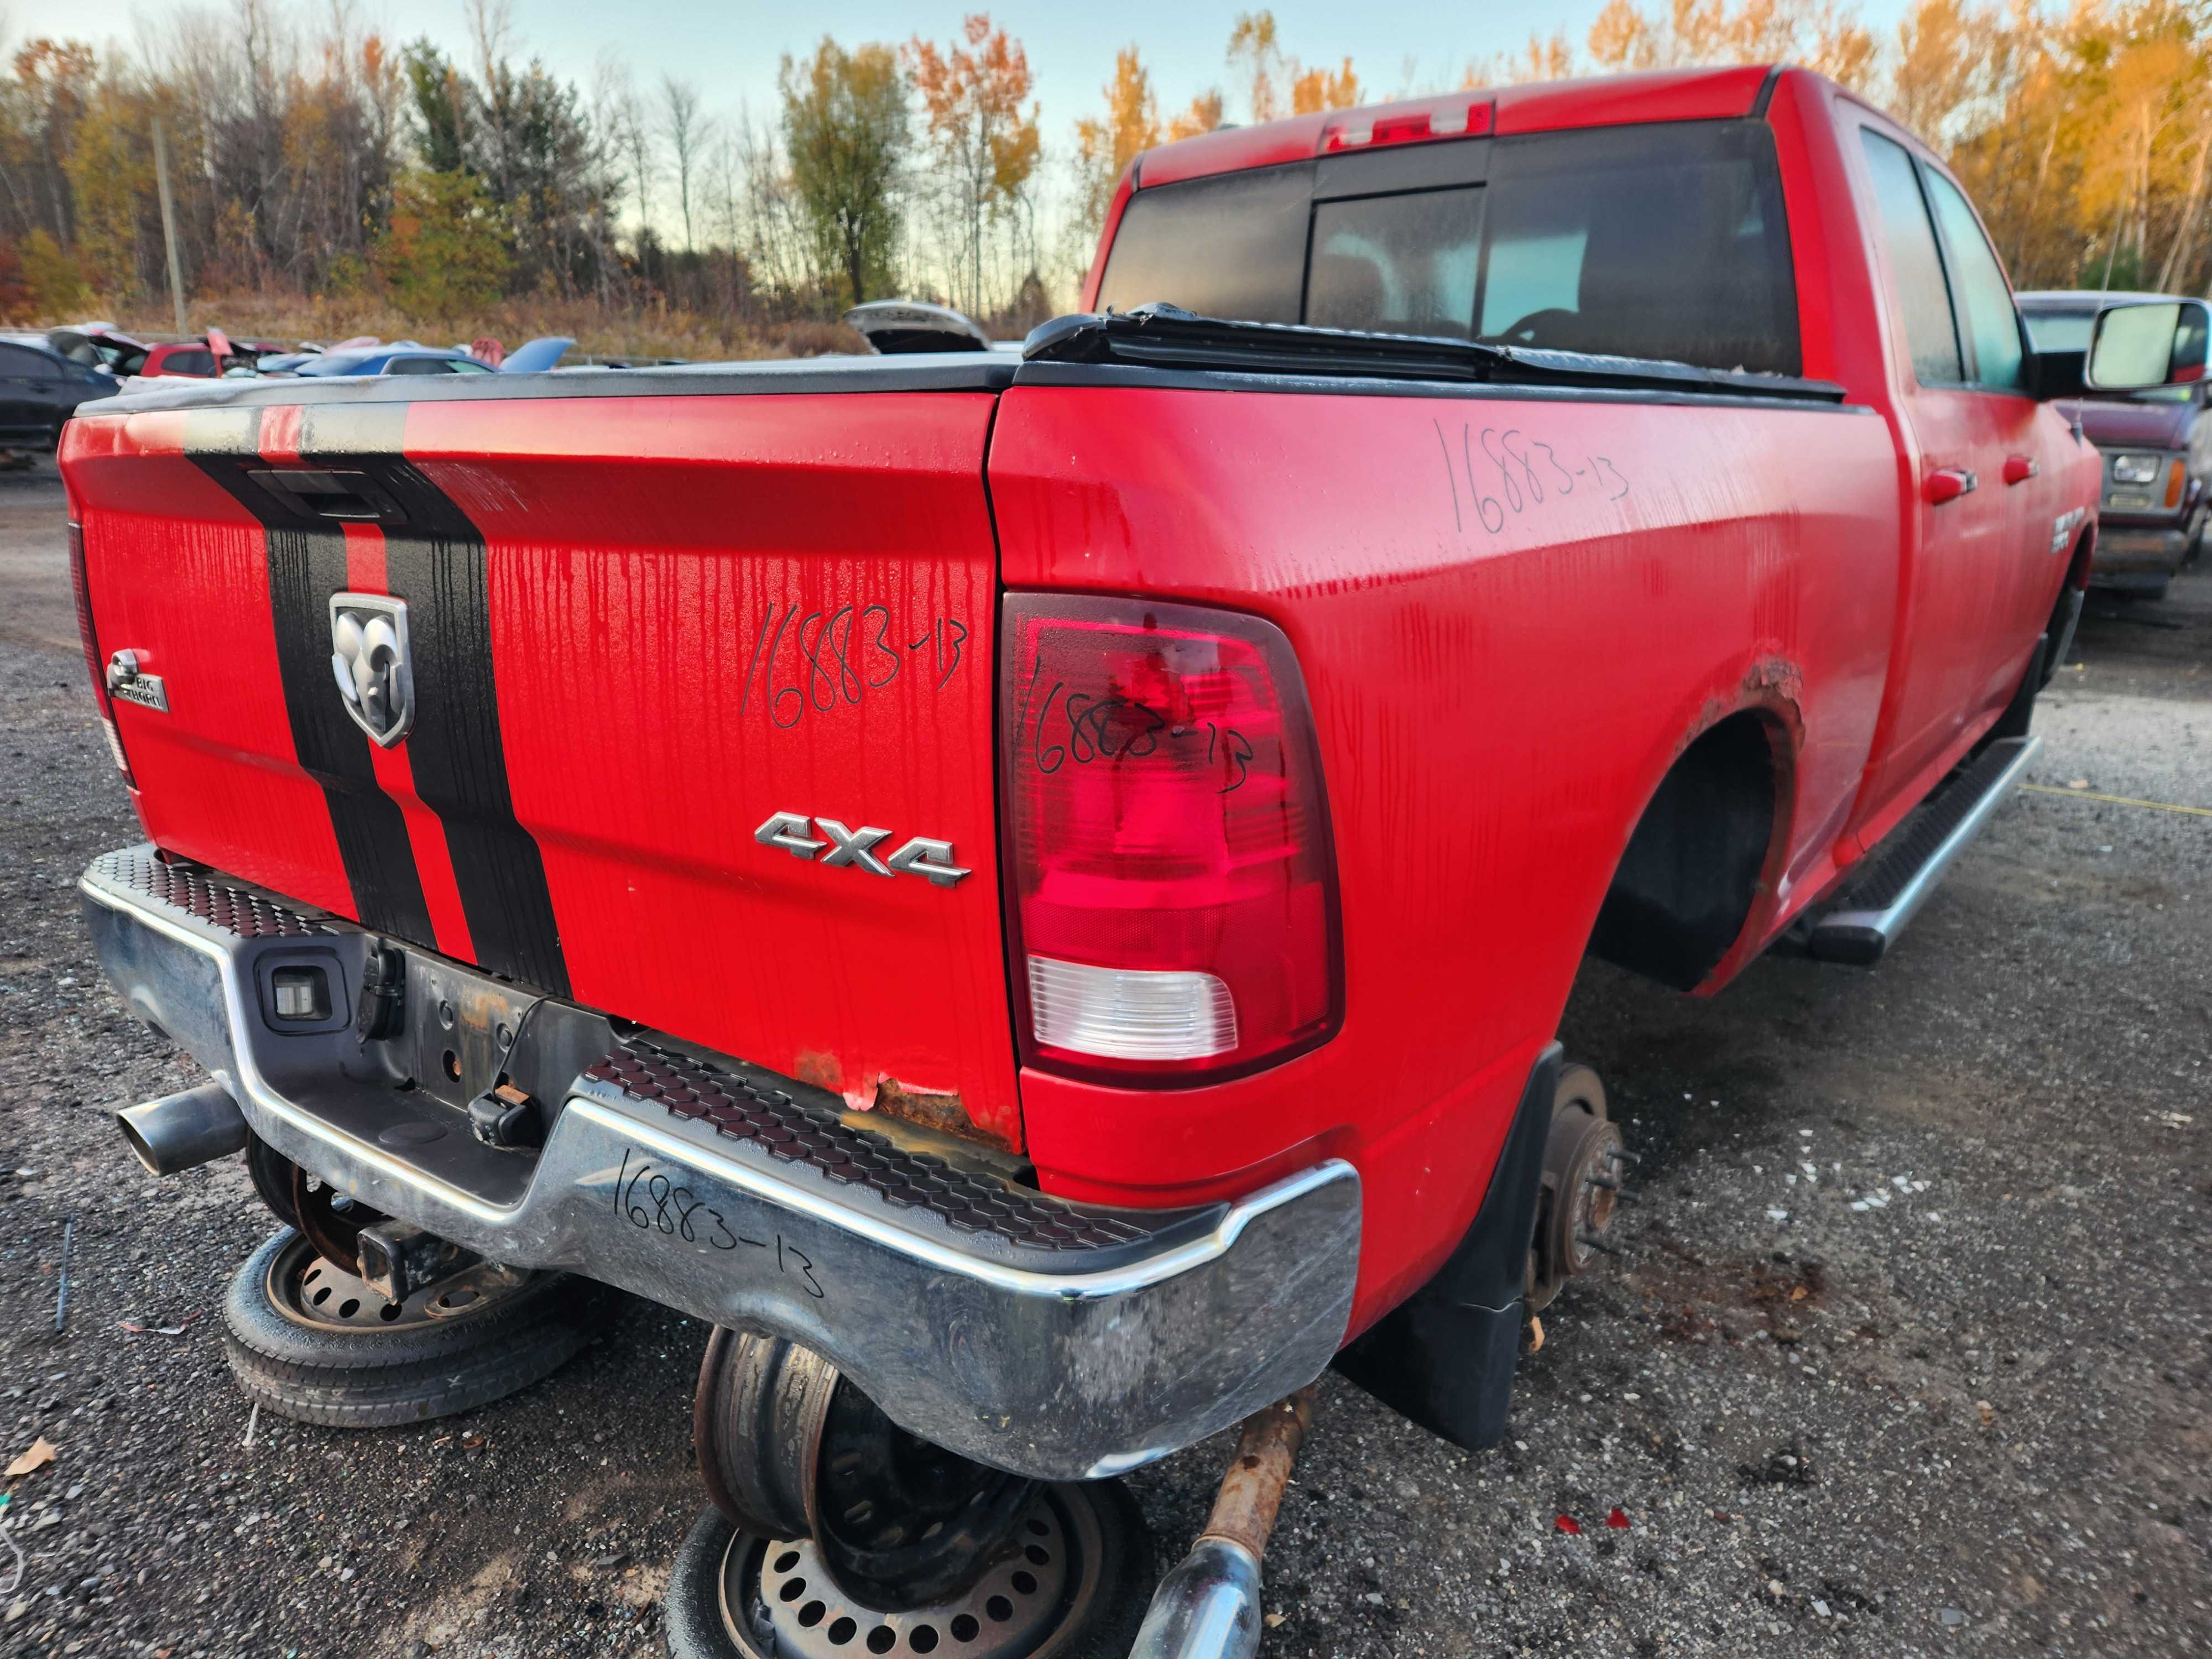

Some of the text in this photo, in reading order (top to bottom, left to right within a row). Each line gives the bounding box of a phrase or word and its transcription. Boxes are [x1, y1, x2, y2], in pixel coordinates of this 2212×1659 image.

[1433, 418, 1629, 534] 16883-13
[136, 676, 154, 691] BIG
[740, 601, 968, 729] 16883-13
[1015, 656, 1254, 794] 16883-13
[614, 1148, 825, 1298] 16883-13
